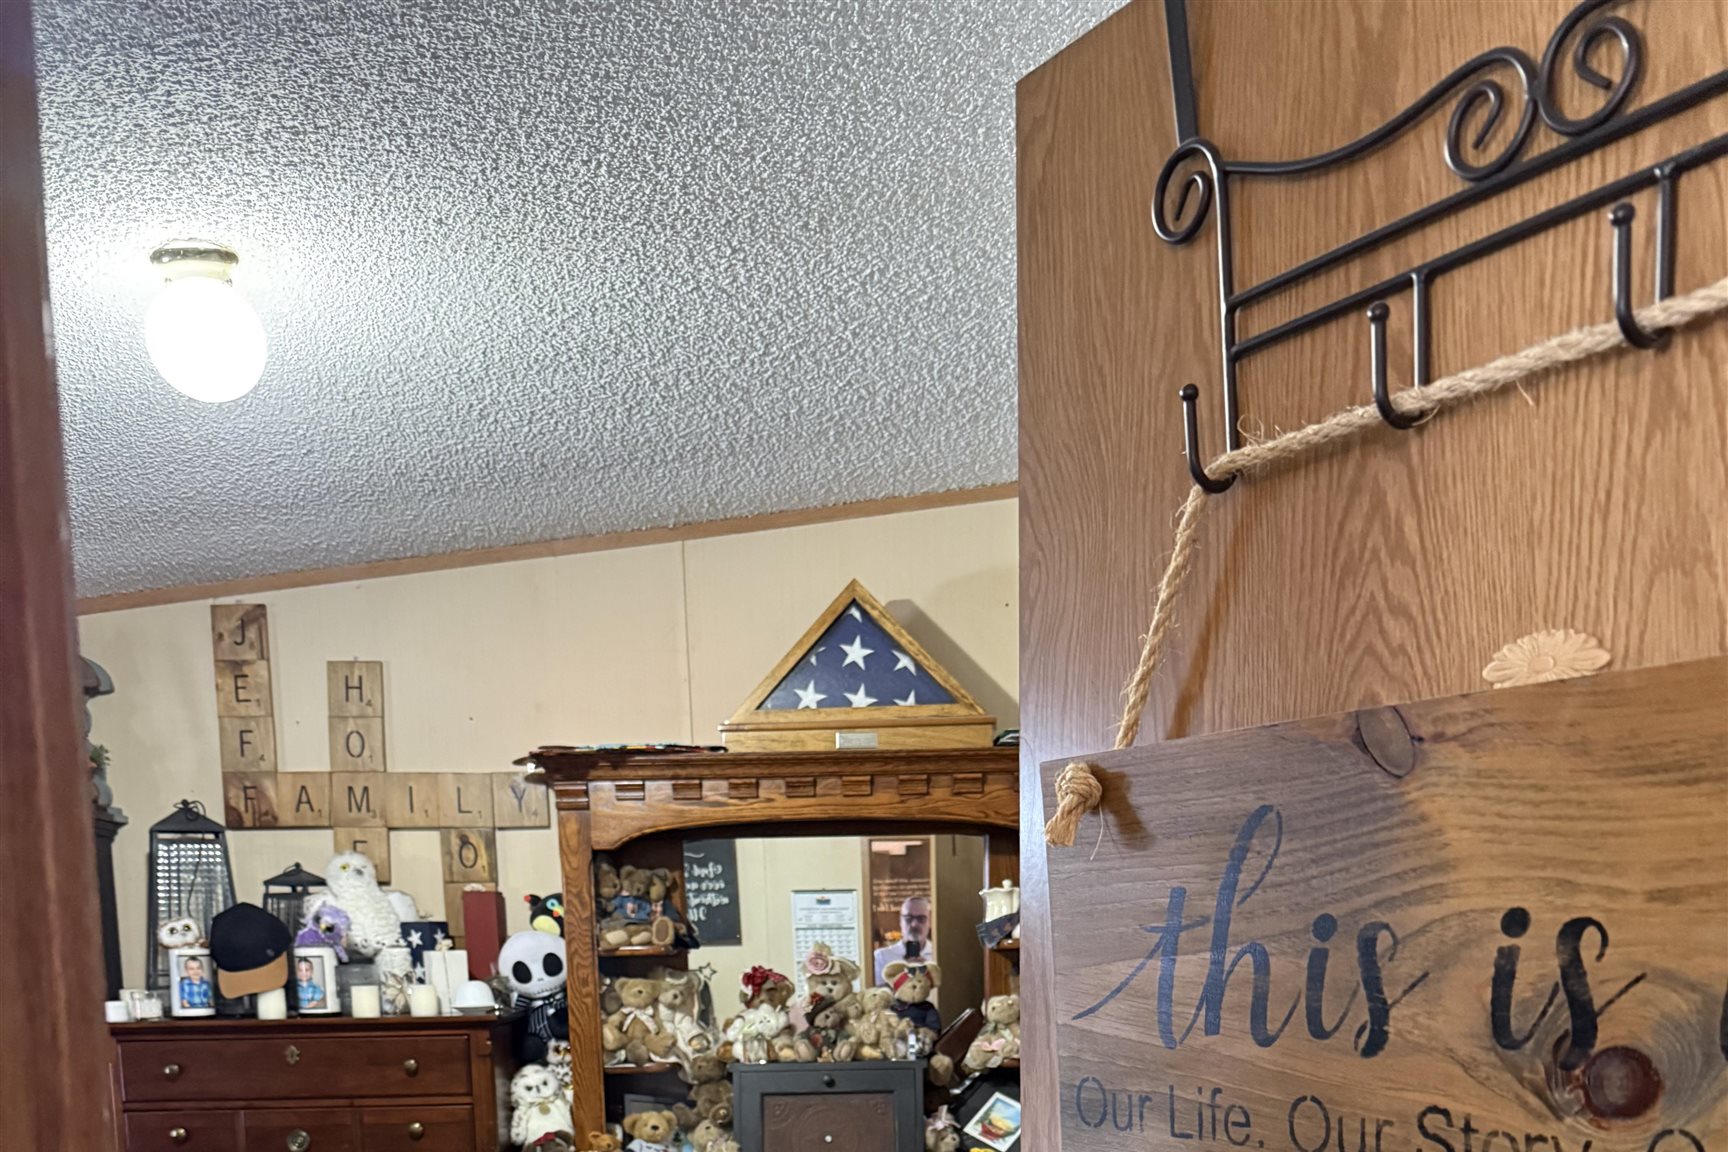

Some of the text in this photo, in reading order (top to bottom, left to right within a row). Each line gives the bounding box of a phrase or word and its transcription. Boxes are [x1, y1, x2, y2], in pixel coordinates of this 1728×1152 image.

[242, 785, 527, 814] FAMILY
[1072, 804, 1429, 1058] this
[1490, 906, 1647, 1071] is
[1076, 1076, 1152, 1136] Our
[1169, 1084, 1264, 1149] Life.
